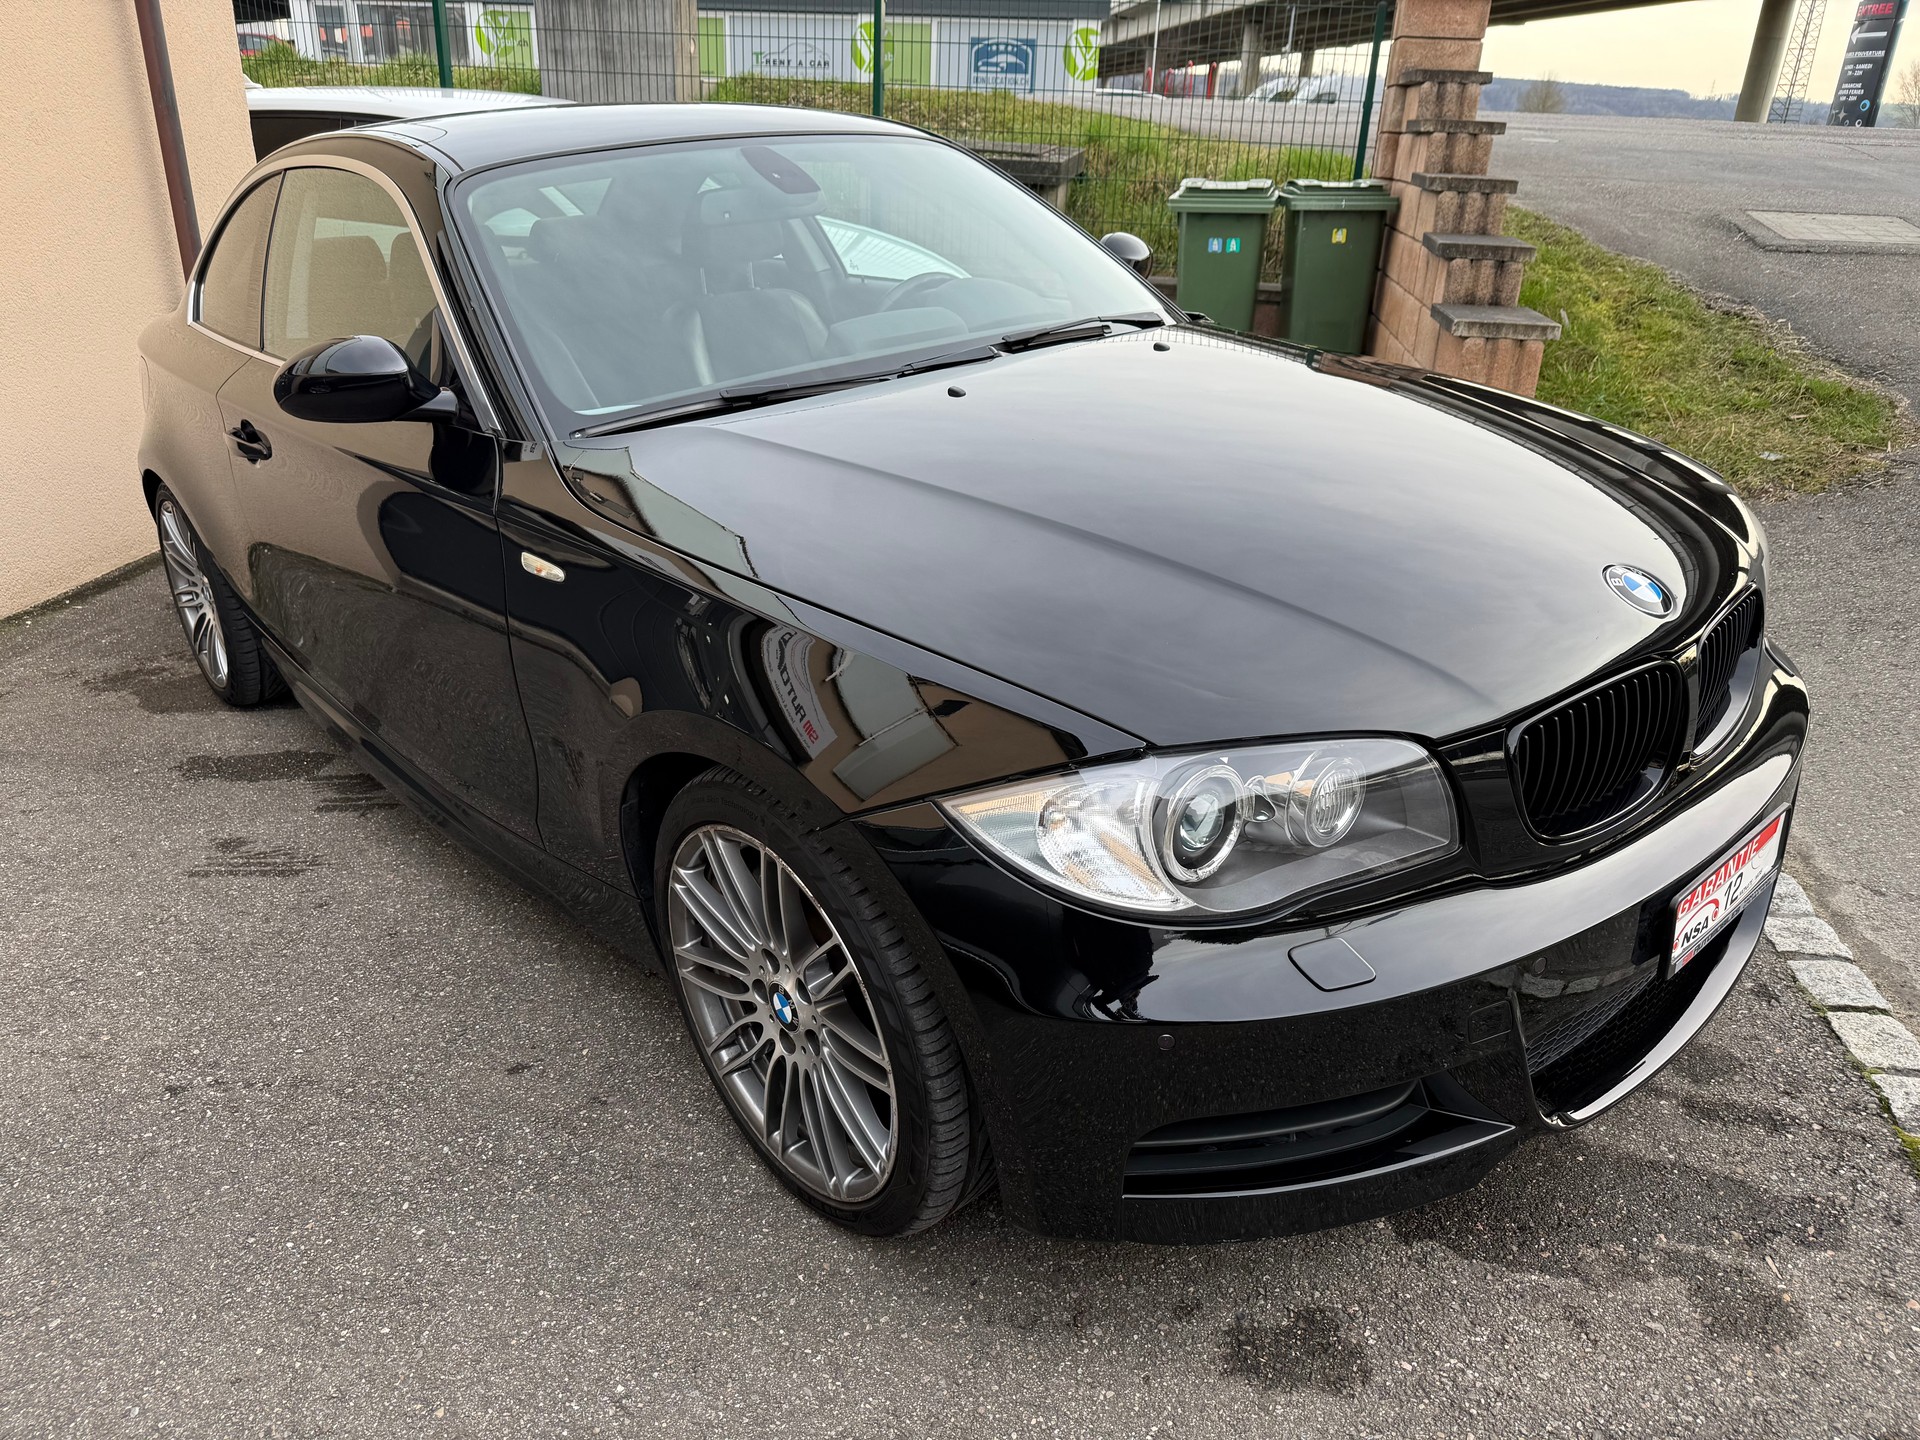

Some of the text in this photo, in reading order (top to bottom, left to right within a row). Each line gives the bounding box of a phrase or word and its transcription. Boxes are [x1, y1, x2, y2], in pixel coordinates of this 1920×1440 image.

[1857, 3, 1893, 16] ENTREE
[809, 59, 830, 67] CAR
[1680, 836, 1760, 915] GARANTIE
[1723, 871, 1744, 911] 12
[1681, 916, 1709, 948] NSA
